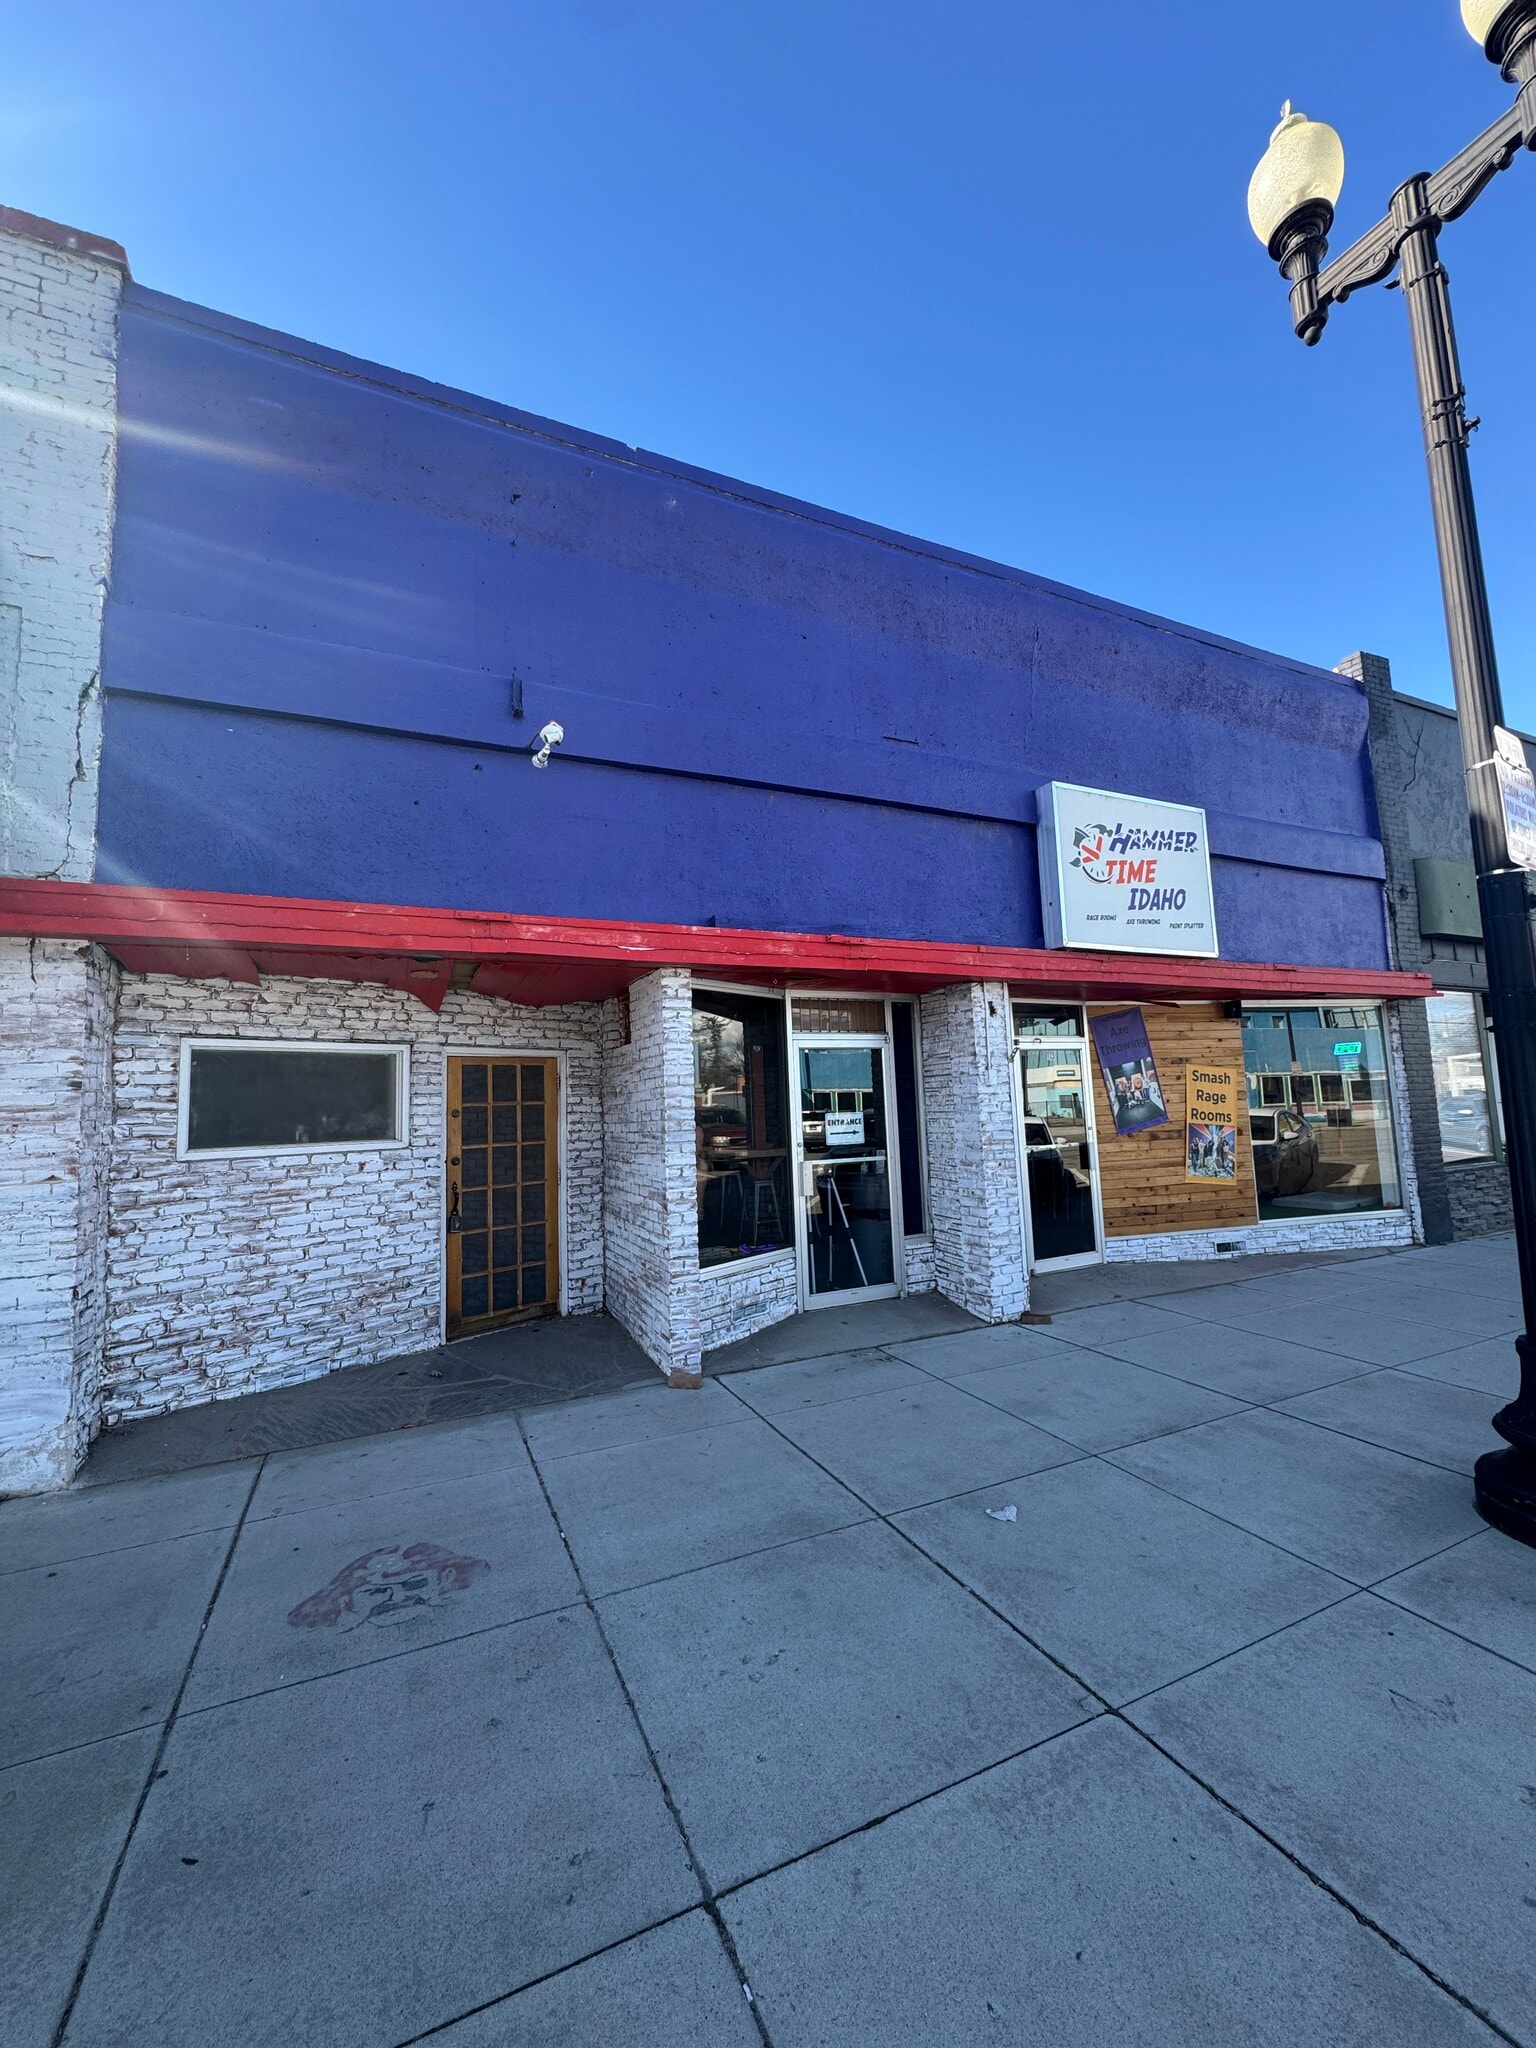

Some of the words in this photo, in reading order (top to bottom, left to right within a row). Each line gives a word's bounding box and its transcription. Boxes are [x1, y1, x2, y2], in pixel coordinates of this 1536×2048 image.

[1109, 823, 1198, 855] HAMMER
[1105, 859, 1158, 884] TIME
[1128, 888, 1187, 911] IDAHO
[1110, 1025, 1129, 1038] Axe
[1099, 1037, 1146, 1056] Throwing
[1191, 1070, 1231, 1085] Smash
[1196, 1089, 1227, 1105] Rage
[827, 1117, 862, 1126] ENTRANCE
[1191, 1108, 1232, 1123] Rooms
